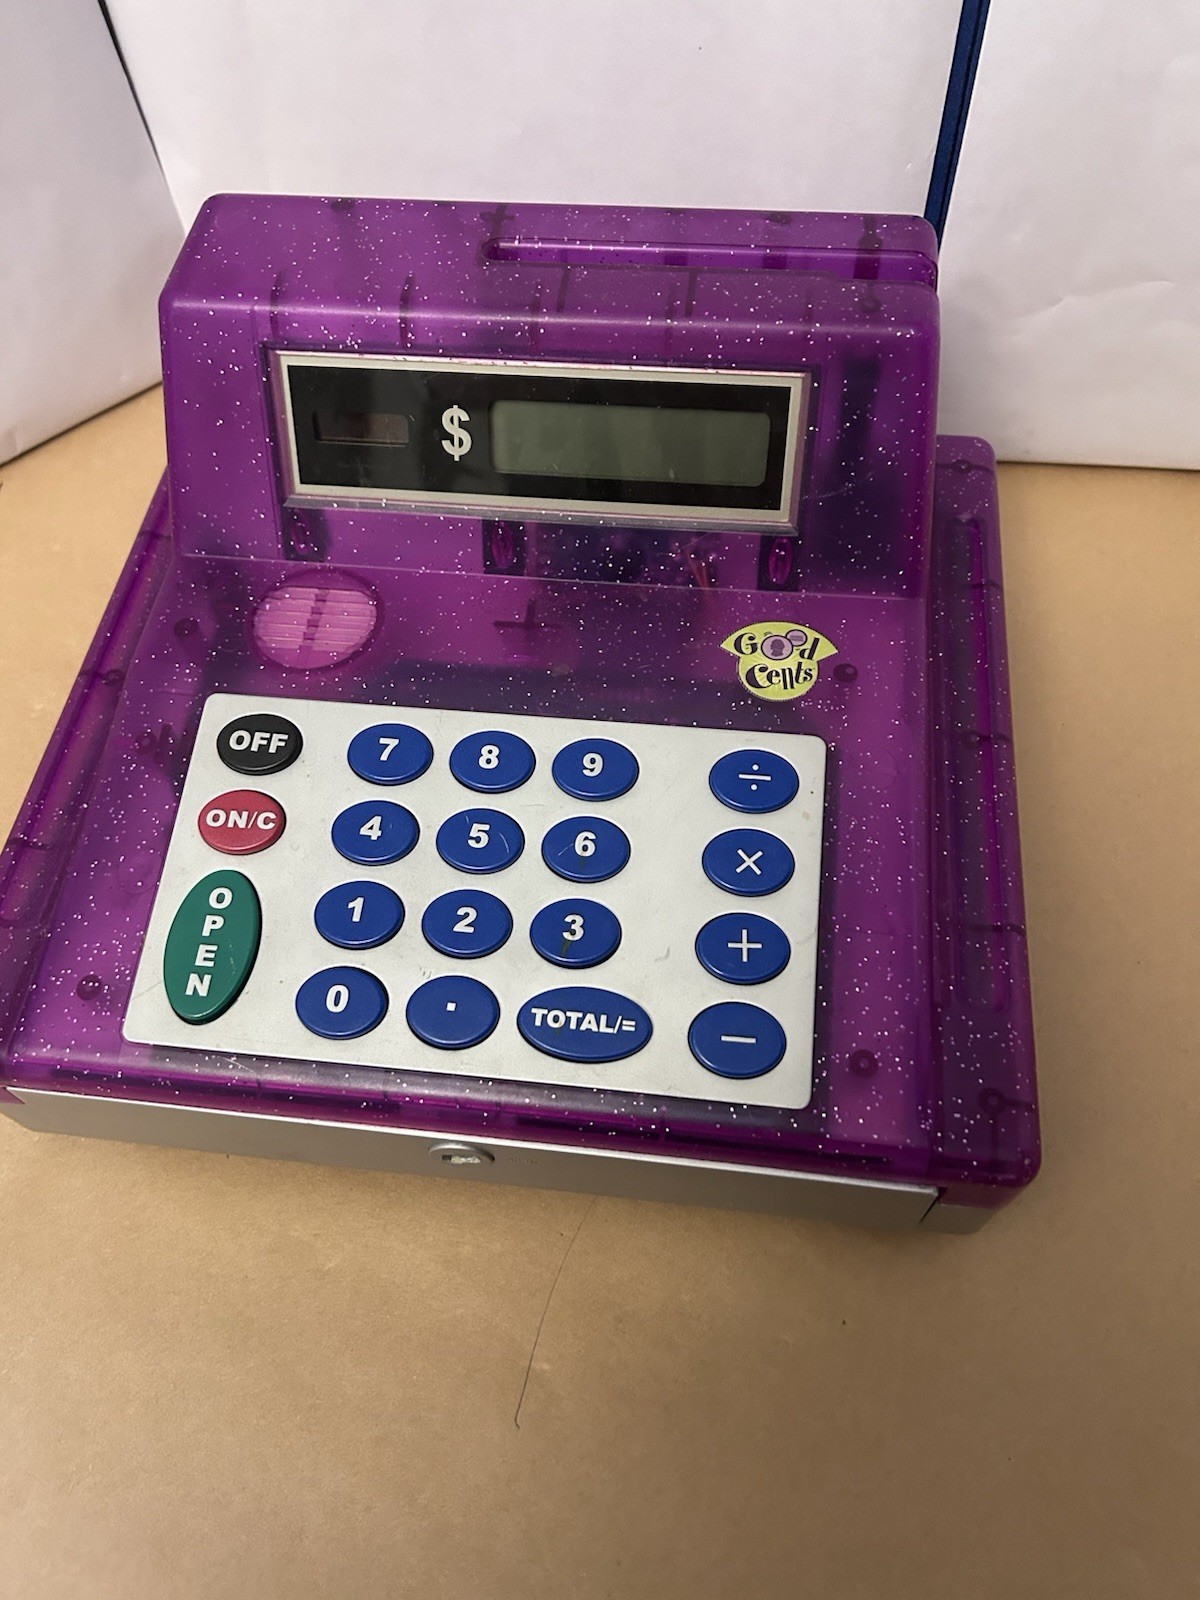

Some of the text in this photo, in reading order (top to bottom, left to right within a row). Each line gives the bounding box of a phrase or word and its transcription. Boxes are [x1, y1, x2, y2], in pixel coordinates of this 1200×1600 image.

[442, 405, 472, 462] $
[733, 629, 820, 660] Good
[745, 661, 814, 690] Cents
[228, 730, 289, 754] OFF
[378, 737, 399, 761] 7
[478, 744, 500, 769] 8
[582, 752, 603, 777] 9
[205, 809, 277, 830] ON/C
[359, 815, 382, 841] 4
[467, 823, 490, 849] 5
[574, 831, 597, 857] 6
[347, 896, 364, 923] 1
[452, 906, 477, 934] 2
[562, 914, 584, 941] 3
[184, 886, 233, 998] OPEN
[727, 928, 763, 963] +
[325, 984, 349, 1013] 0
[530, 1007, 636, 1034] TOTAL/=
